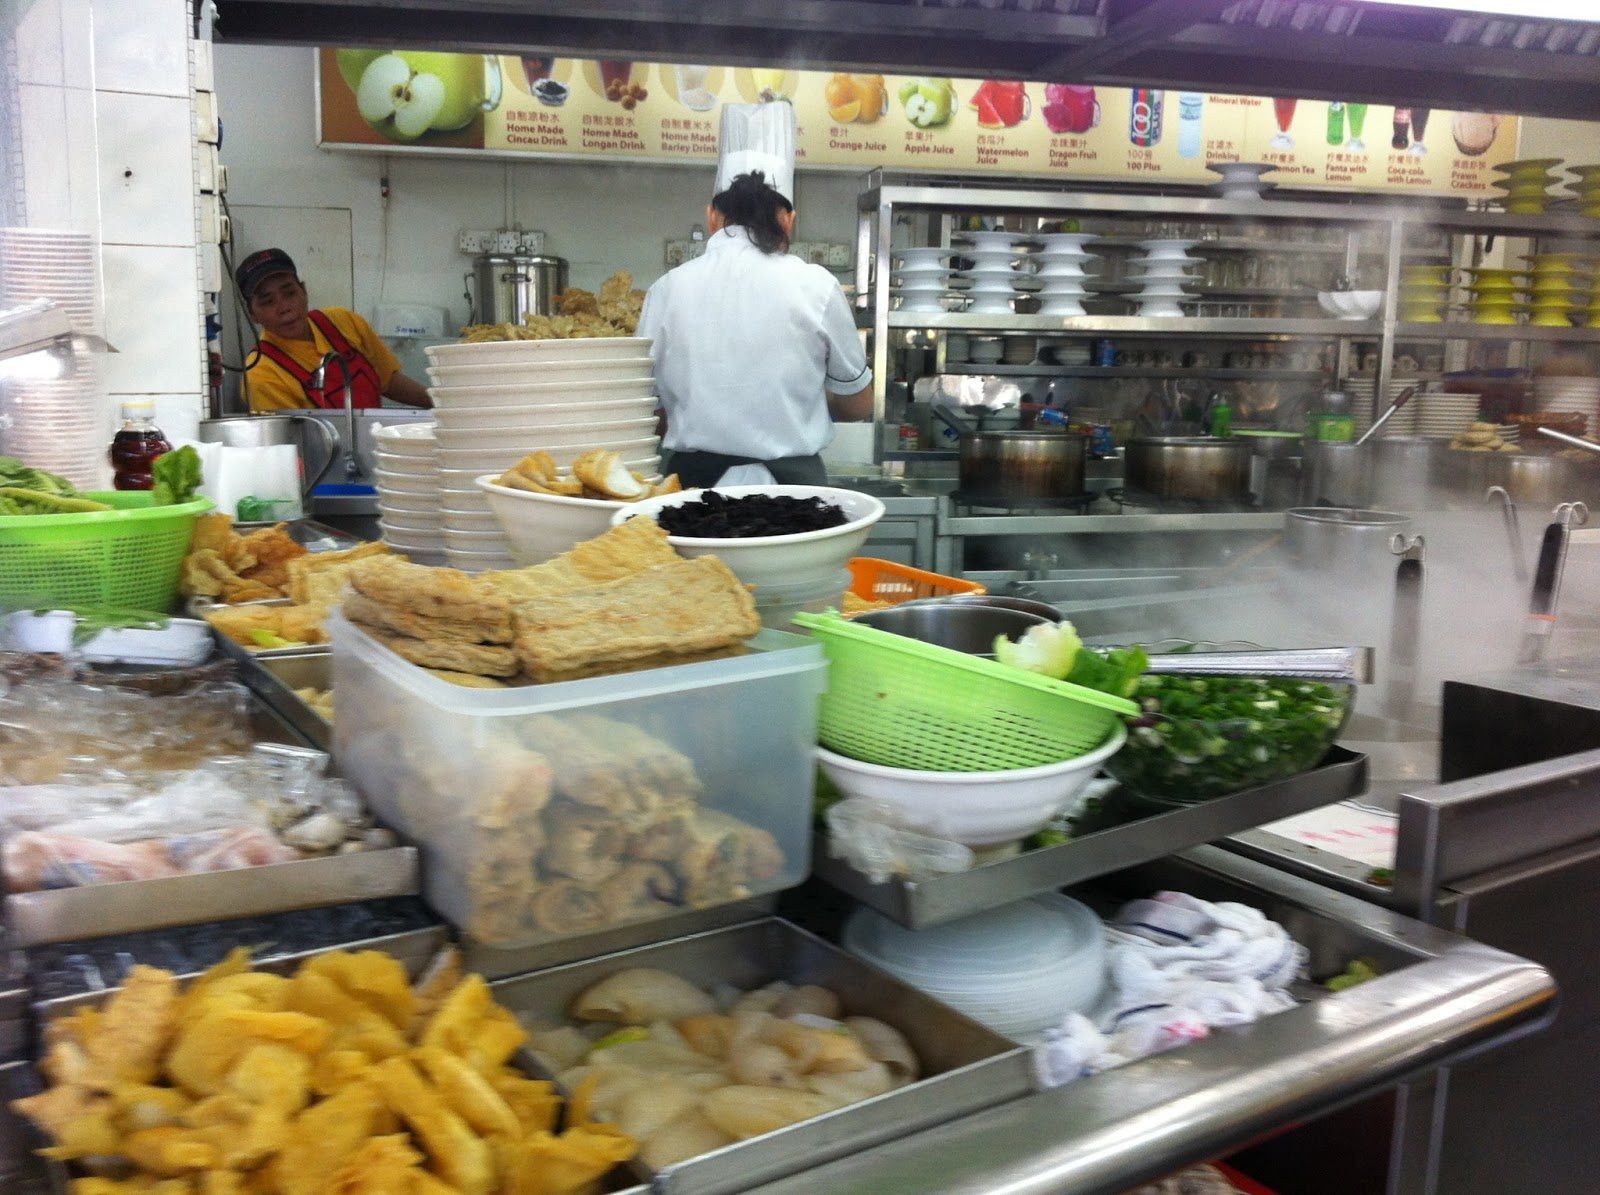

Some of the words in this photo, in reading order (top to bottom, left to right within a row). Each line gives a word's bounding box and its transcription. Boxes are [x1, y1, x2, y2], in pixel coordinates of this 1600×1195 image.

[1209, 95, 1239, 105] Mineral
[1240, 98, 1262, 106] Water
[506, 124, 537, 134] Home
[537, 126, 565, 135] Made
[582, 128, 611, 138] Home
[612, 130, 639, 139] Made
[506, 135, 540, 145] Cincau
[541, 136, 568, 147] Drink
[661, 132, 689, 141] Home
[690, 134, 717, 143] Made
[582, 140, 618, 150] Longan
[619, 141, 646, 150] Drink
[661, 142, 690, 153] Barley
[692, 144, 718, 154] Drink
[829, 139, 862, 151] Orange
[864, 141, 887, 151] Juice
[904, 143, 930, 154] Apple
[932, 146, 954, 154] Juice
[976, 147, 1029, 157] Watermelon
[1049, 149, 1077, 160] Dragon
[1079, 151, 1097, 160] Fruit
[1206, 152, 1240, 163] Drinking
[976, 156, 998, 165] Juice
[1049, 159, 1068, 168] Juice
[1126, 161, 1142, 171] 100
[1143, 163, 1161, 172] Plus
[1302, 165, 1315, 174] Tea
[1326, 163, 1348, 173] Fanta
[1349, 166, 1367, 174] with
[1387, 166, 1424, 176] Coca-cola
[1325, 173, 1352, 182] Lemon
[1387, 176, 1405, 184] with
[1405, 177, 1432, 185] Lemon
[1452, 170, 1478, 180] Prawn
[1451, 180, 1486, 190] Crackers
